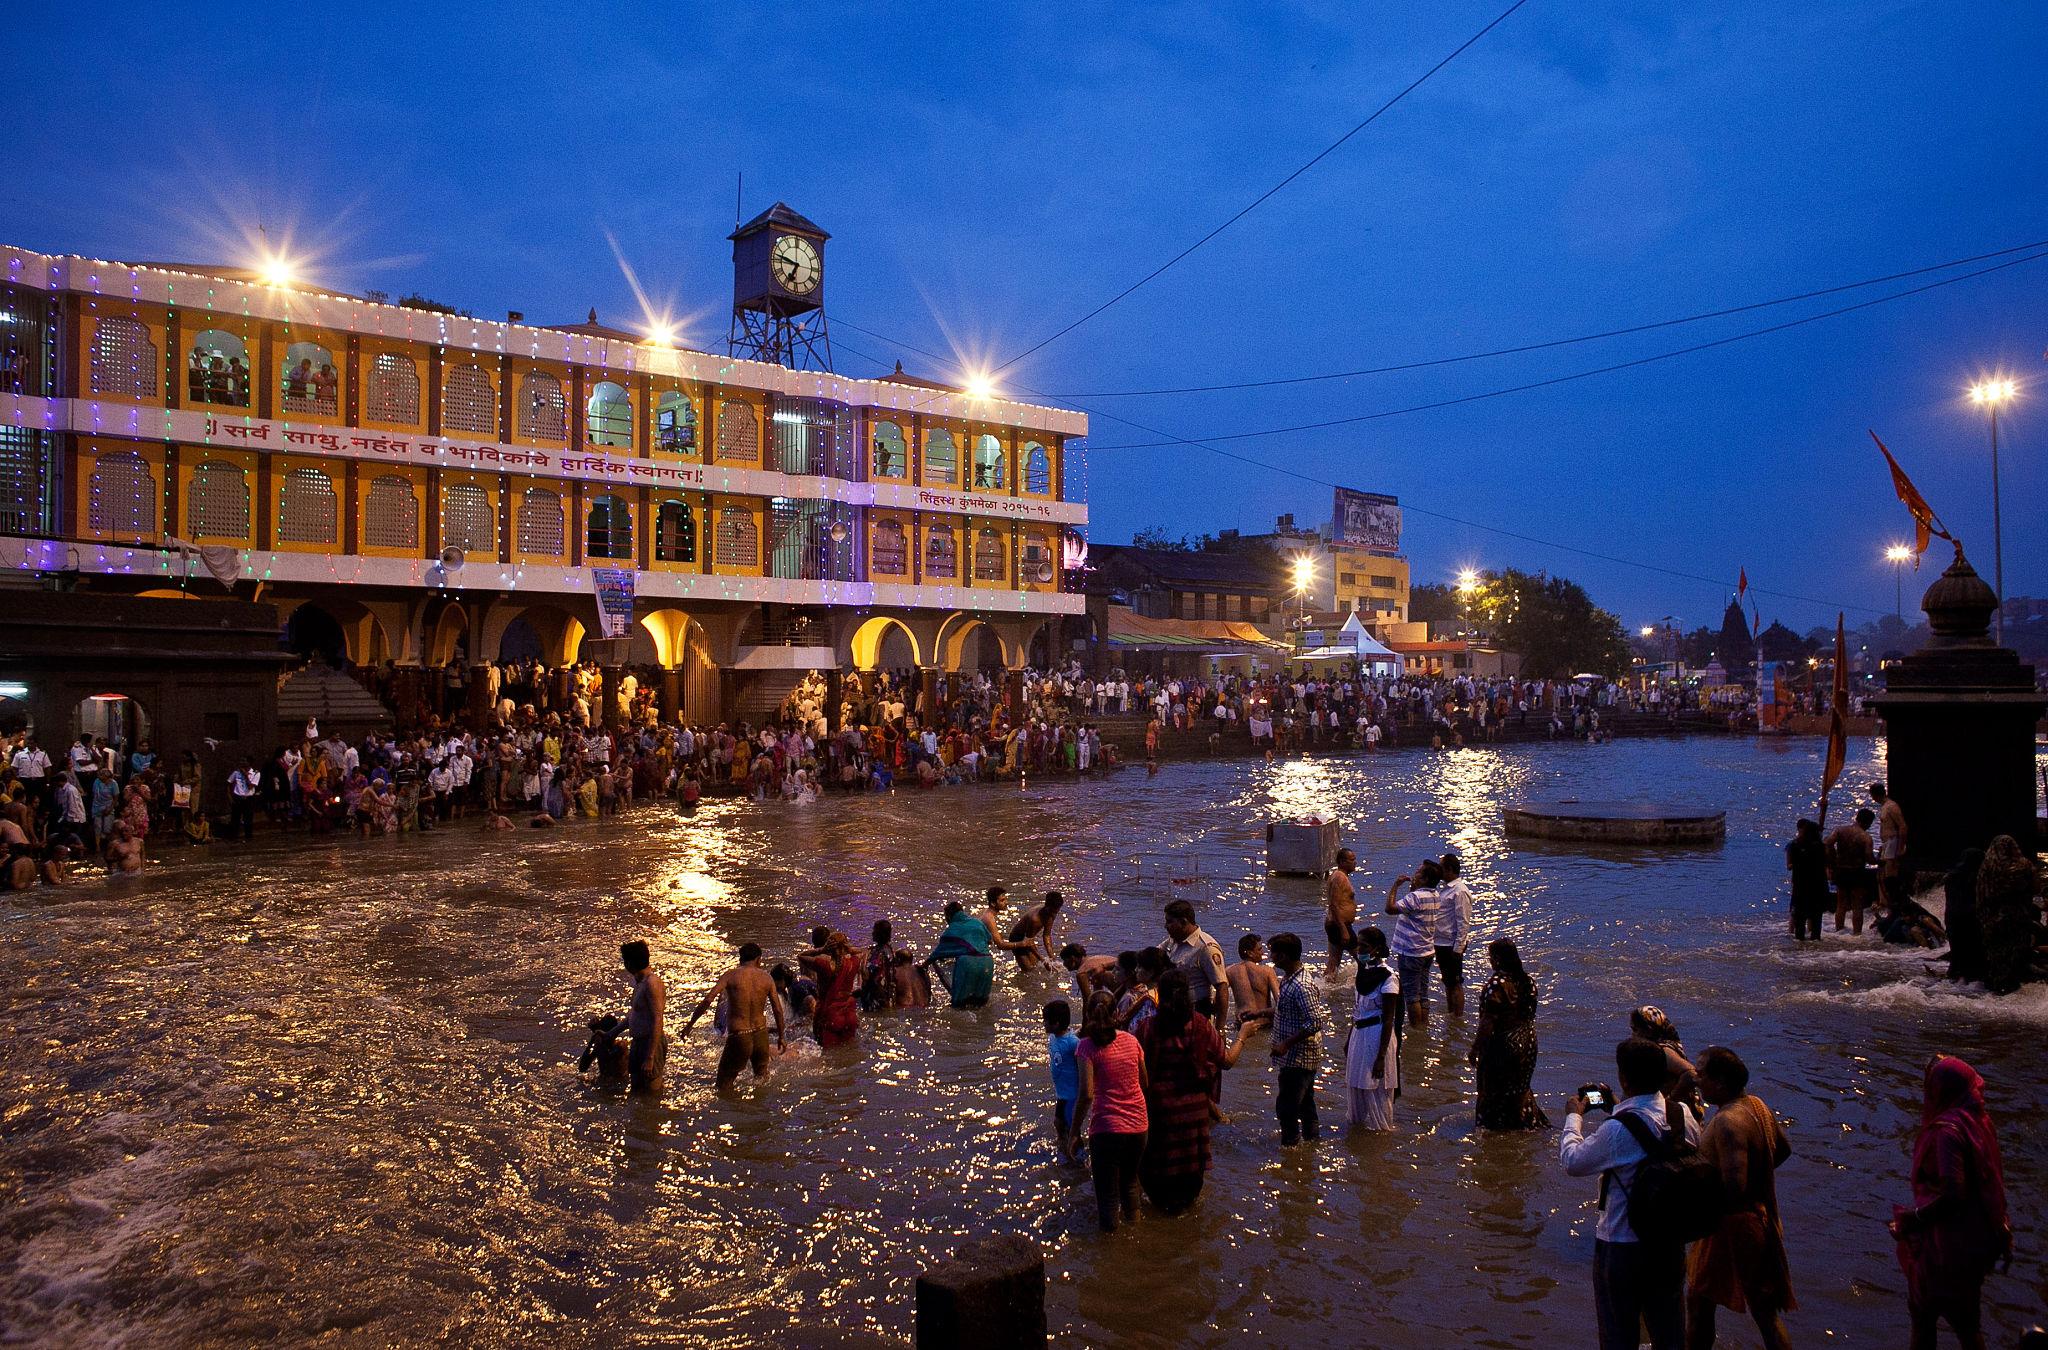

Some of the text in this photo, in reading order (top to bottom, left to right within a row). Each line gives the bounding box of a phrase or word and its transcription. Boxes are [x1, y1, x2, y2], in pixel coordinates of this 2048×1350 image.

[223, 424, 271, 440] सर्व
[419, 443, 439, 456] व
[449, 446, 551, 467] भाविकांचे
[559, 457, 626, 475] हार्दिक
[919, 490, 956, 507] सिंहस्थ
[959, 495, 998, 510] कुंभमेळा
